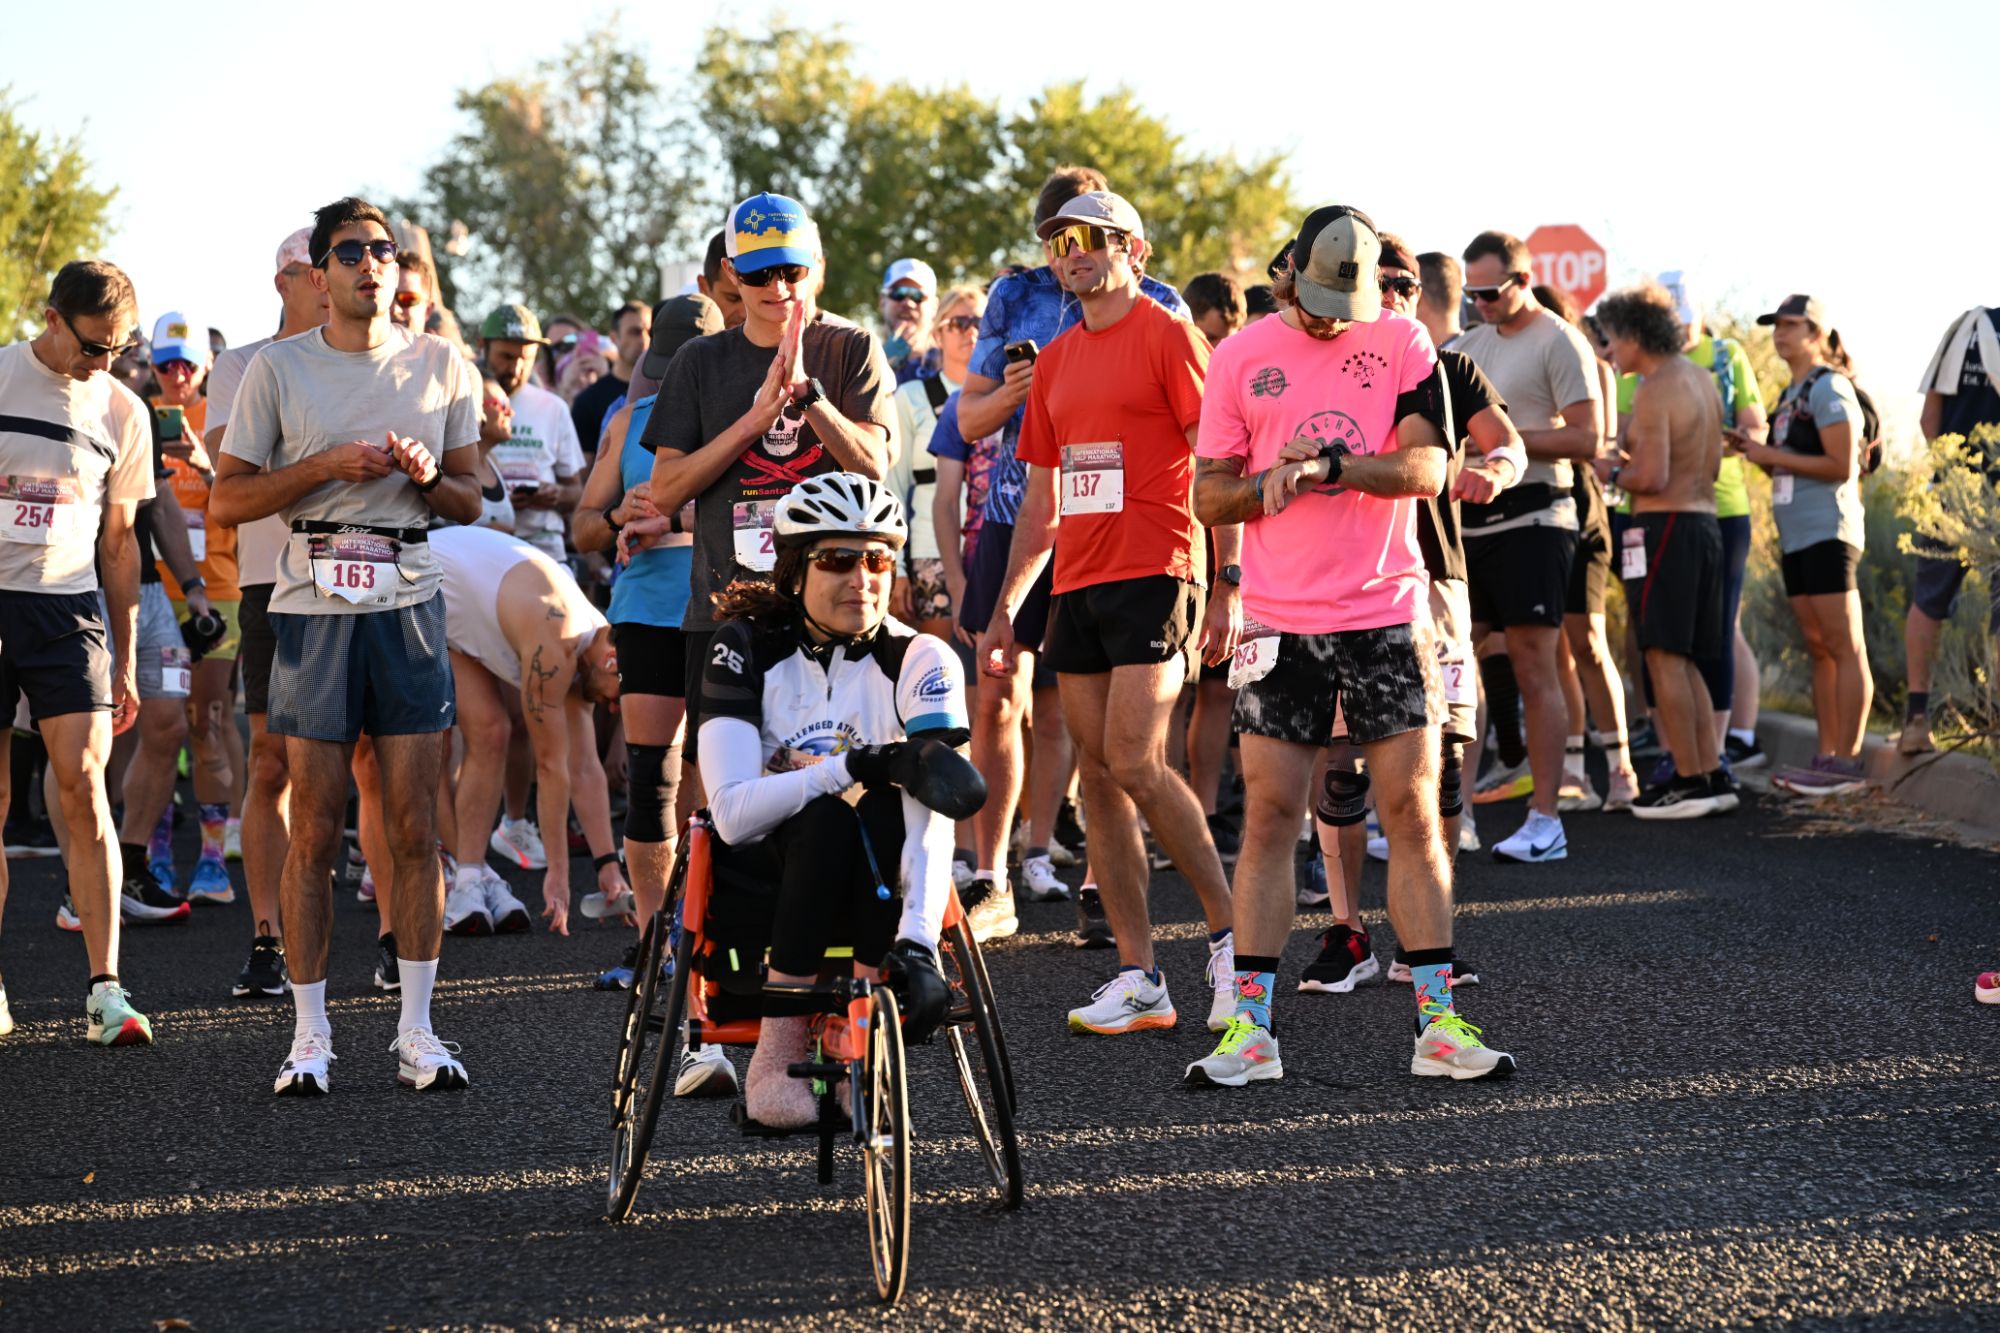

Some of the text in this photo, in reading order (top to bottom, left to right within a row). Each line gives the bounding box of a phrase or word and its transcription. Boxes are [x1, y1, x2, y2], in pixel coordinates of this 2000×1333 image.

[1072, 473, 1101, 497] 137
[14, 504, 55, 528] 254
[1105, 502, 1116, 510] 137
[341, 539, 392, 550] INTERNATIONA
[333, 563, 375, 589] 163
[712, 643, 745, 675] 25
